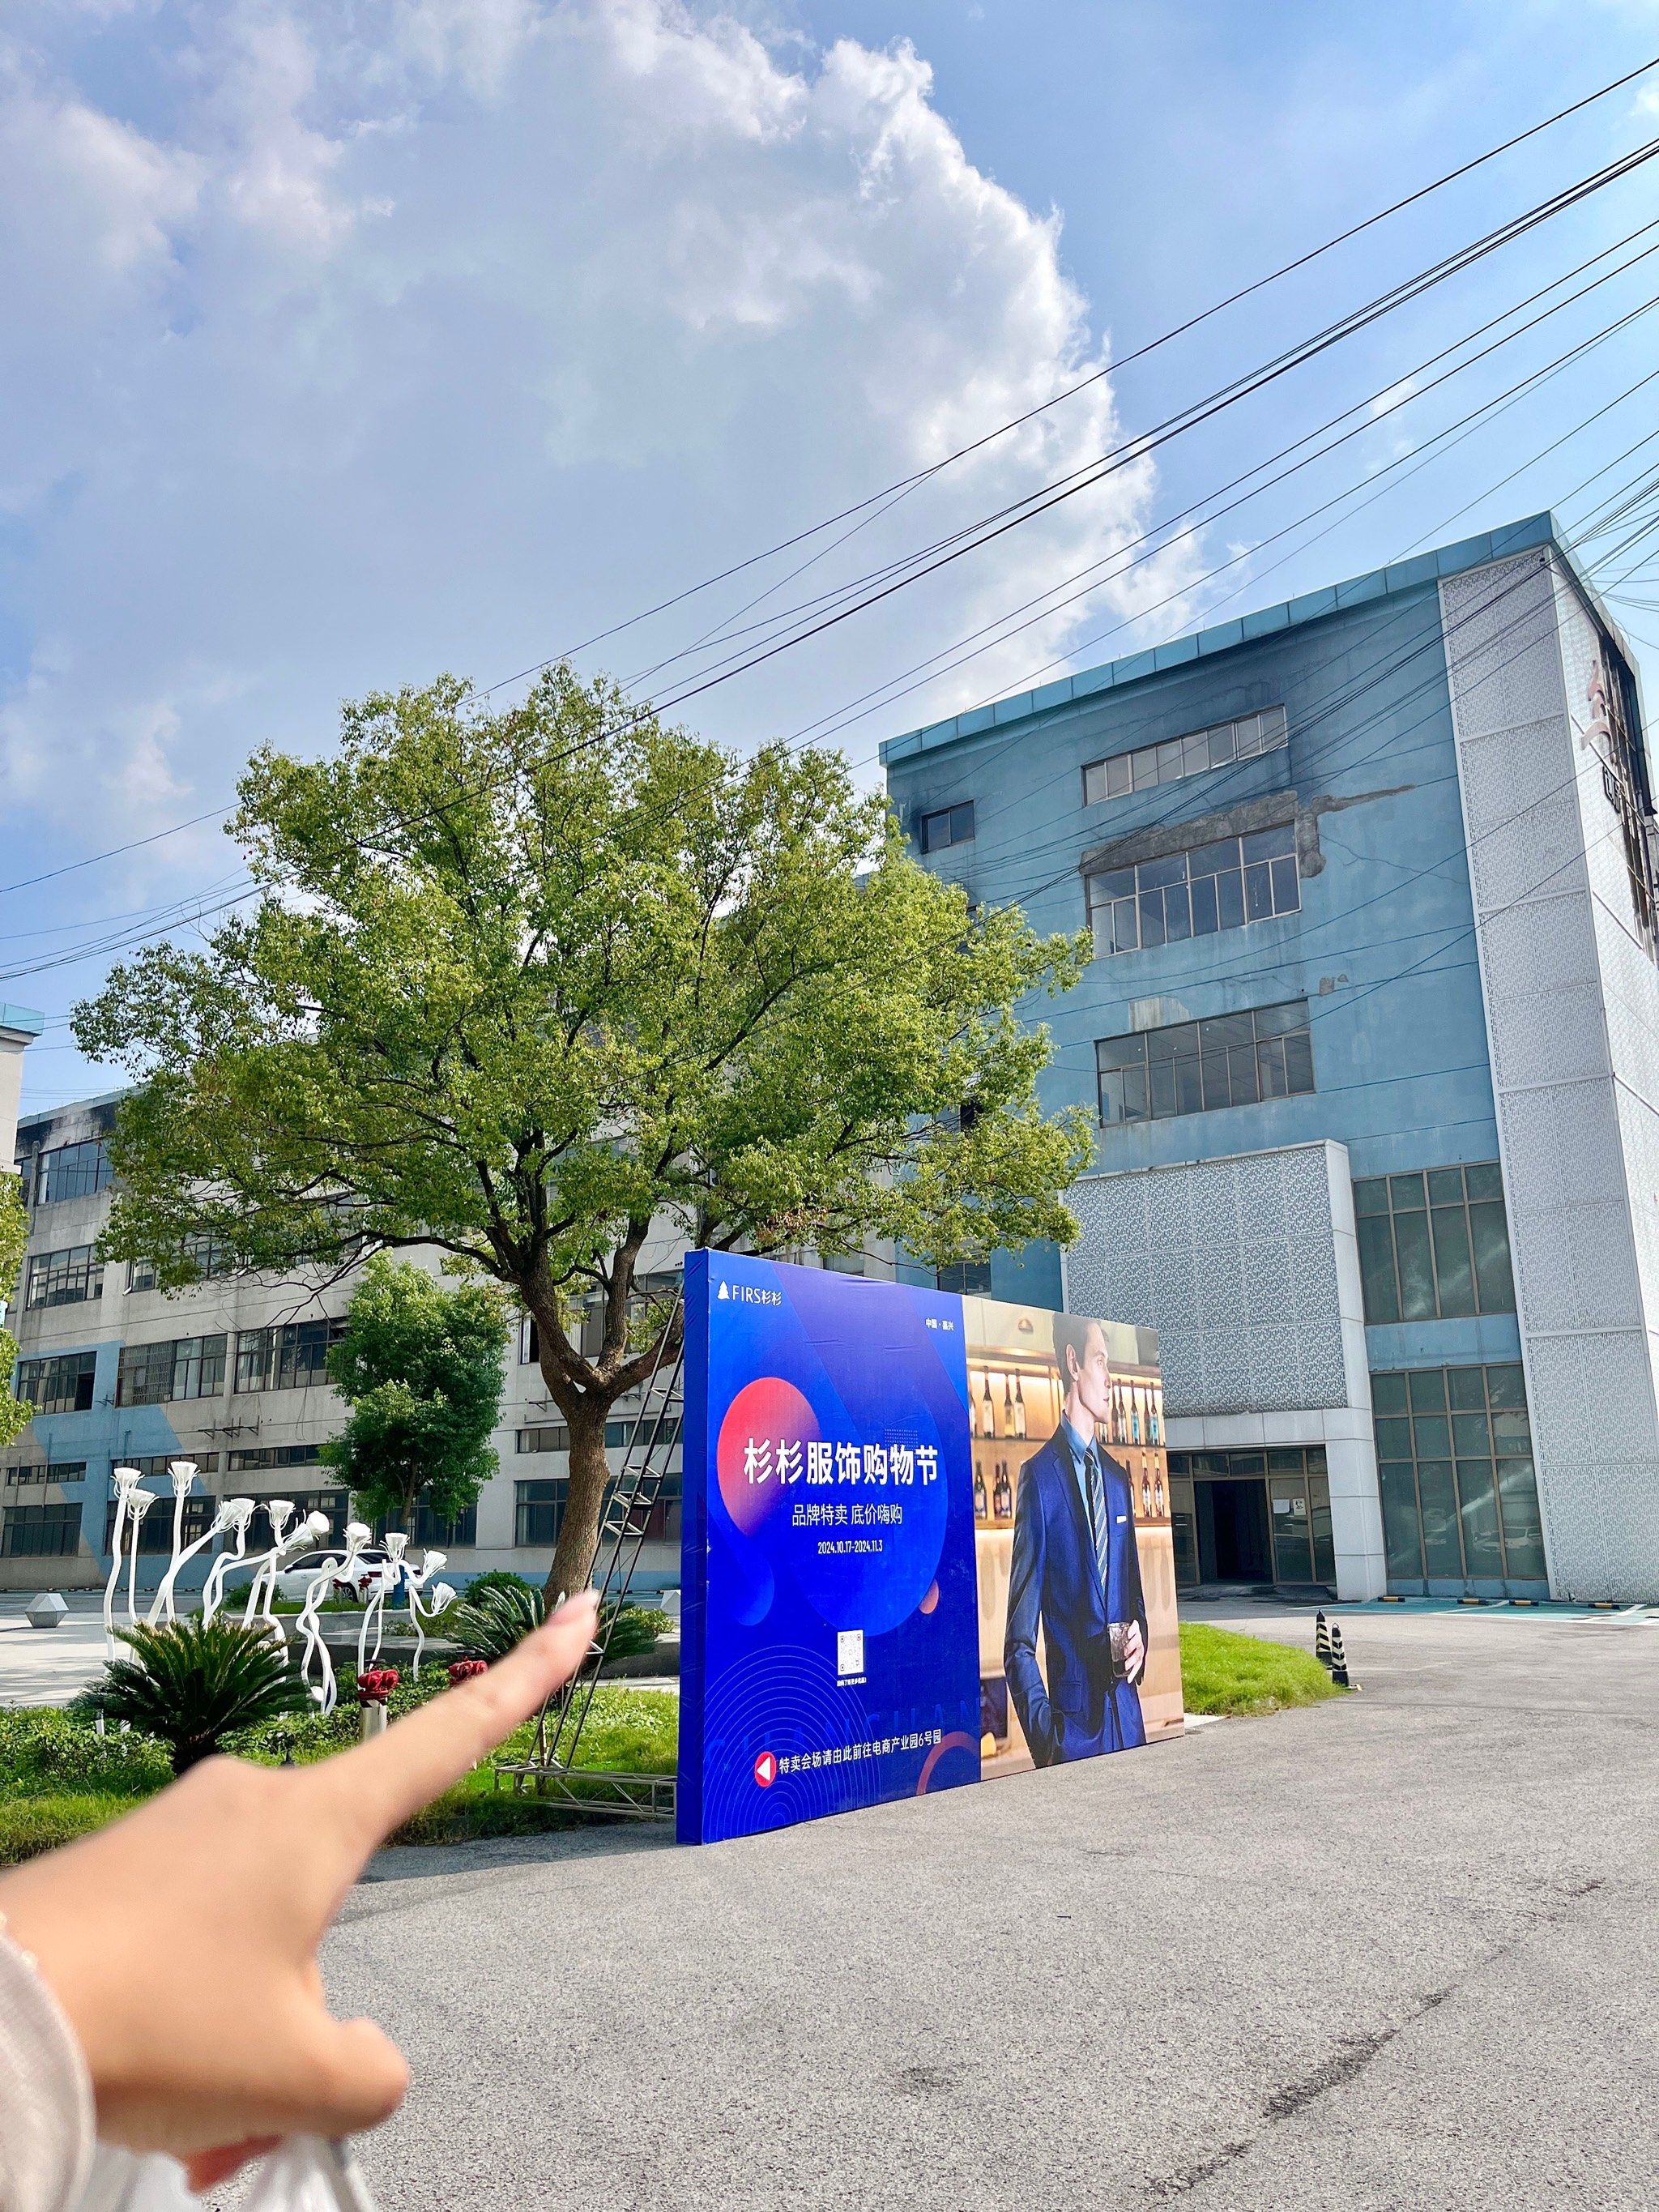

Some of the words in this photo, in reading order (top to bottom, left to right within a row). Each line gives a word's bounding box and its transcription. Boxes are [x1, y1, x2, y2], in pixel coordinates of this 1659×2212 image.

[743, 1437, 939, 1486] 杉杉服饰购物节
[792, 1504, 848, 1527] 品牌特卖
[851, 1503, 902, 1526] 底价嗨购
[817, 1539, 883, 1555] 2024.10.17-2024.11.3
[778, 1729, 941, 1774] 特卖会场请由此前往电商产业园6号园
